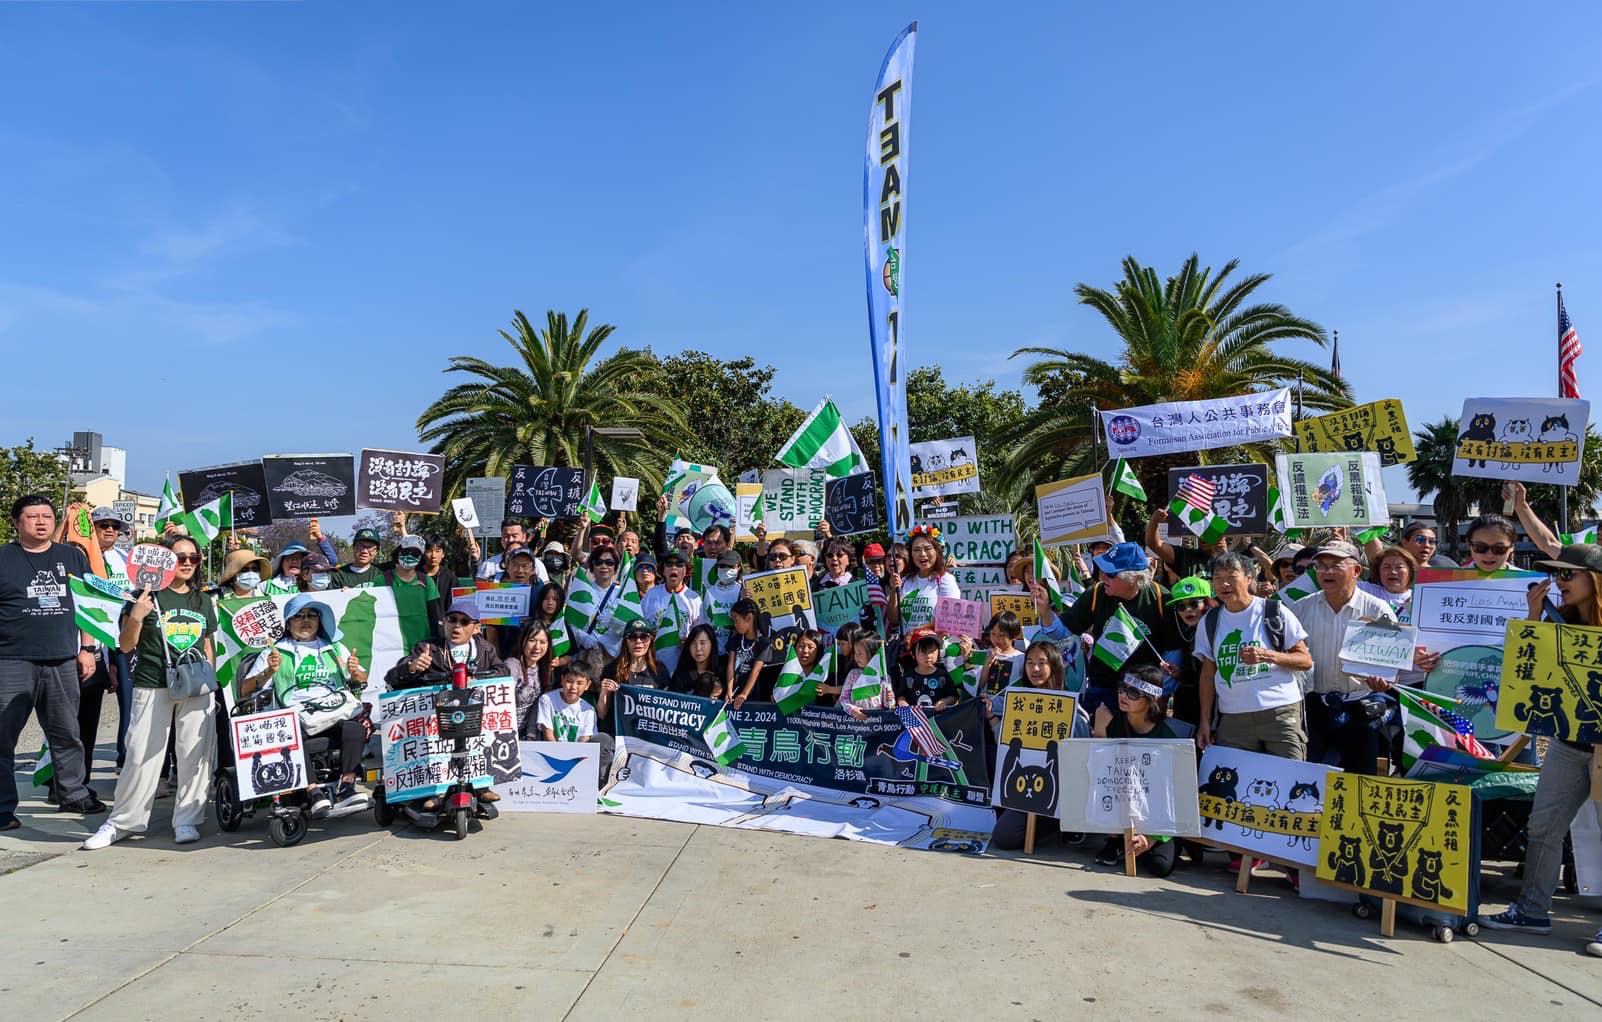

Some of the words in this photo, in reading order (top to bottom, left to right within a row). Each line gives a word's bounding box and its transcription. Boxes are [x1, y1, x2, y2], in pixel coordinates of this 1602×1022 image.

[1151, 400, 1287, 428] 台灣人公共事務會
[1188, 431, 1232, 442] Association
[1233, 428, 1243, 436] for
[765, 492, 778, 512] WE
[779, 478, 794, 521] STAND
[796, 481, 808, 515] WITH
[967, 519, 1013, 534] WITH
[983, 572, 1000, 584] LA
[638, 693, 651, 702] WE
[652, 695, 680, 708] STAND
[680, 700, 701, 711] WITH
[1012, 696, 1064, 713] 我喵視
[623, 694, 706, 731] Democracy
[754, 712, 777, 722] 2024
[801, 709, 821, 718] Federal
[821, 712, 842, 722] Building
[637, 719, 689, 739] 民主站出來
[1012, 719, 1069, 740] 黑箱國會
[668, 740, 688, 751] STAND
[737, 726, 868, 768] 青鳥行動
[1114, 755, 1136, 765] KEEP
[737, 762, 757, 774] STAND
[758, 767, 774, 777] WITH
[774, 770, 814, 785] DEMOCRACY
[1106, 766, 1145, 778] TAIWAN
[1330, 776, 1348, 831] 反擴權
[1368, 786, 1425, 806] 沒有討論
[1369, 801, 1422, 820] 不是民主
[1443, 790, 1462, 852] 反黑箱
